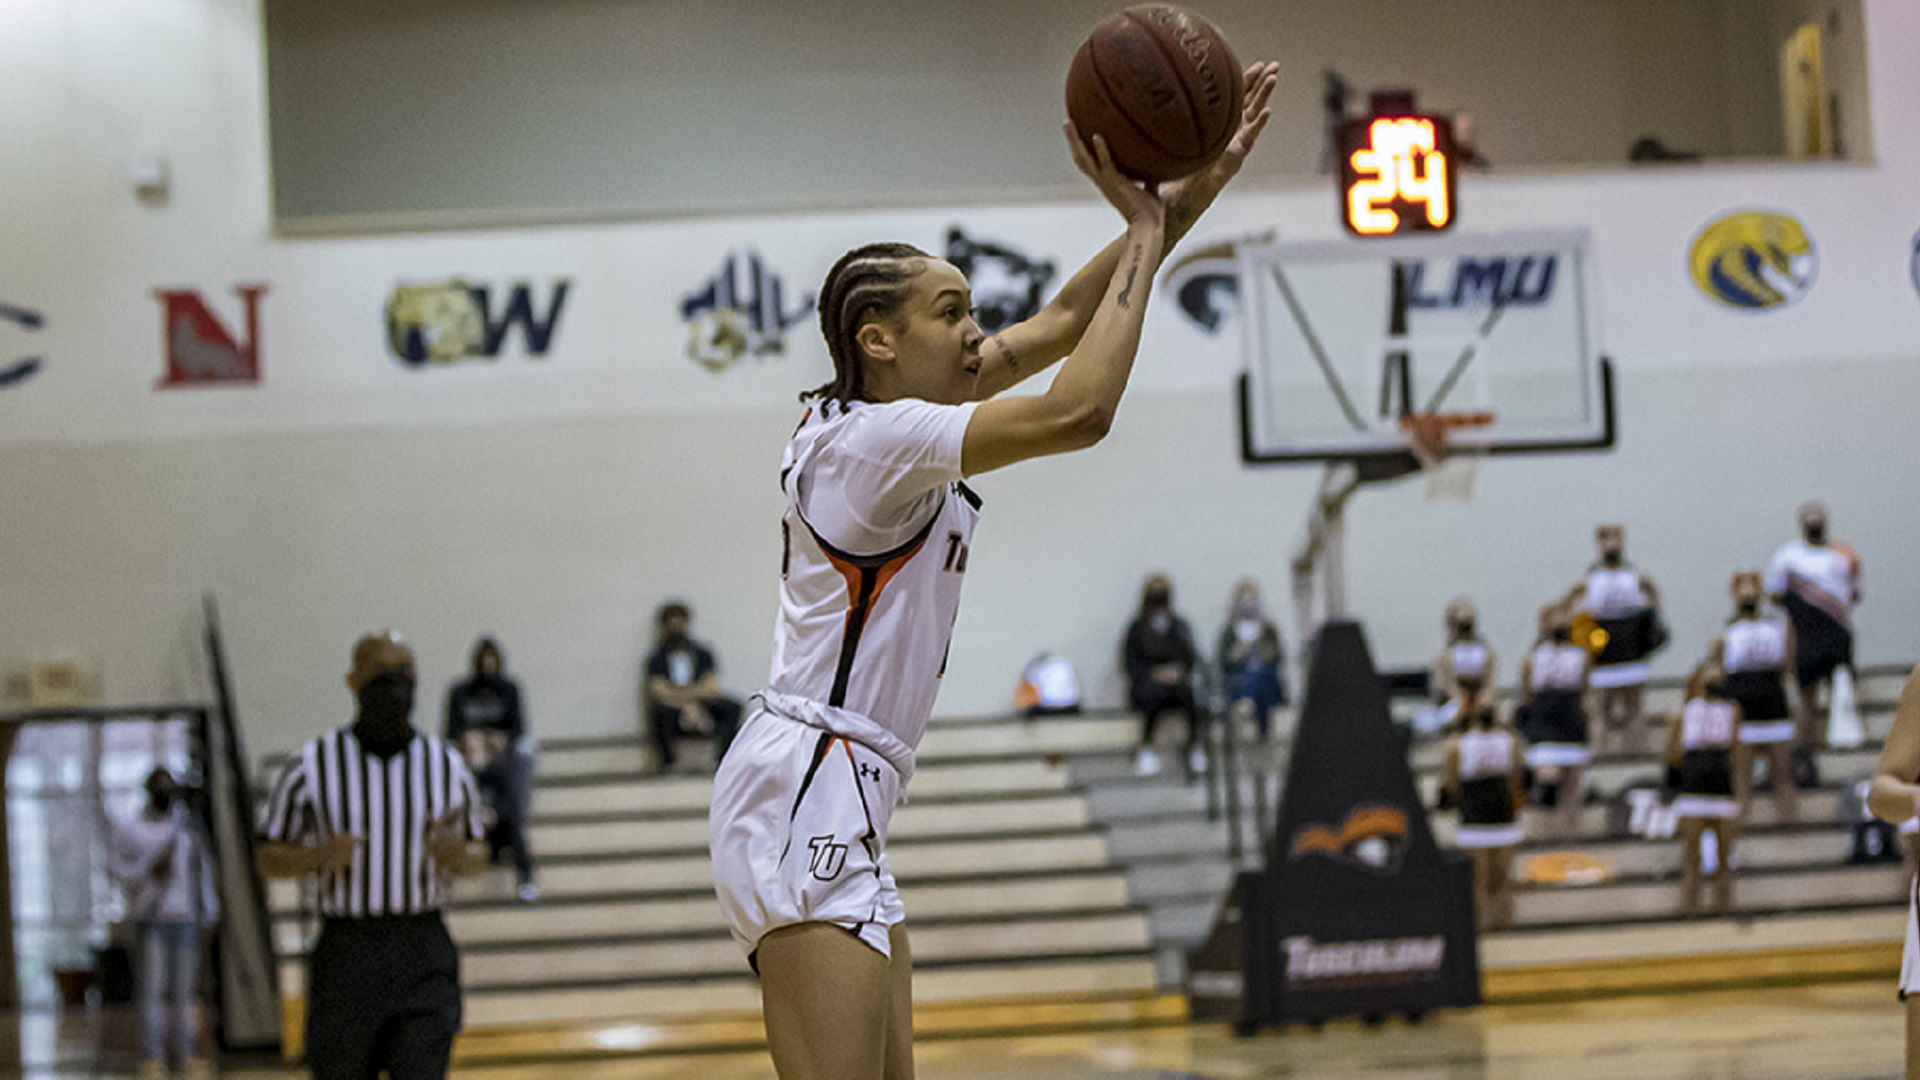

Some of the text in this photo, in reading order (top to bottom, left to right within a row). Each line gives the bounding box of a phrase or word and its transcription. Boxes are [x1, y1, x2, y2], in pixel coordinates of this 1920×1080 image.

[1348, 148, 1450, 235] 24
[463, 281, 568, 360] W
[1400, 253, 1557, 309] LMU
[154, 282, 269, 390] N
[808, 834, 848, 881] TU
